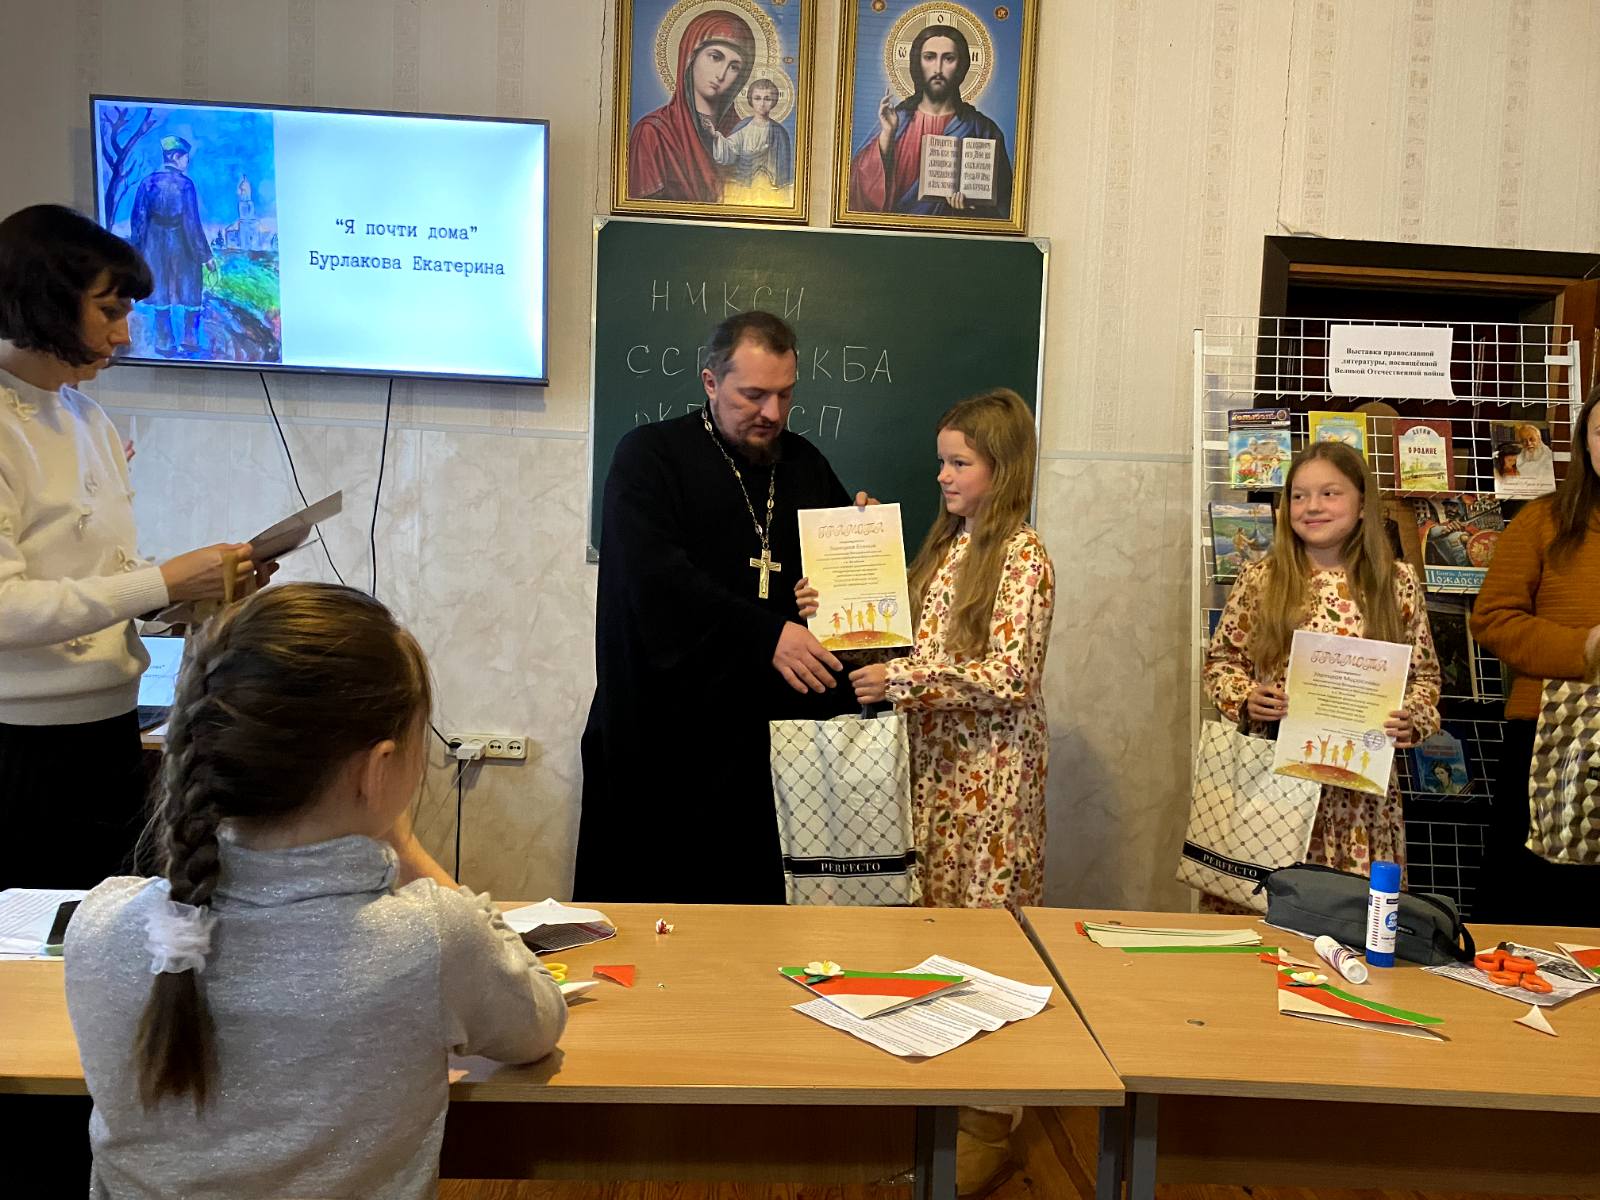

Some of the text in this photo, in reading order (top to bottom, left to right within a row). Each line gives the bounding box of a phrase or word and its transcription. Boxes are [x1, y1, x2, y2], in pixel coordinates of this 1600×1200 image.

[335, 218, 478, 240] “Я почти дома”
[309, 250, 505, 277] Бурлакова Екатерина
[1346, 348, 1434, 358] Выставка православной
[1340, 358, 1387, 367] литературы,
[1334, 367, 1366, 375] Великой
[1367, 368, 1422, 376] Отечественной
[1413, 446, 1438, 455] РОДИНЕ
[1310, 650, 1388, 672] ГРАМОТА
[820, 862, 881, 873] PERFECTO
[1202, 853, 1258, 878] PERFECTO
